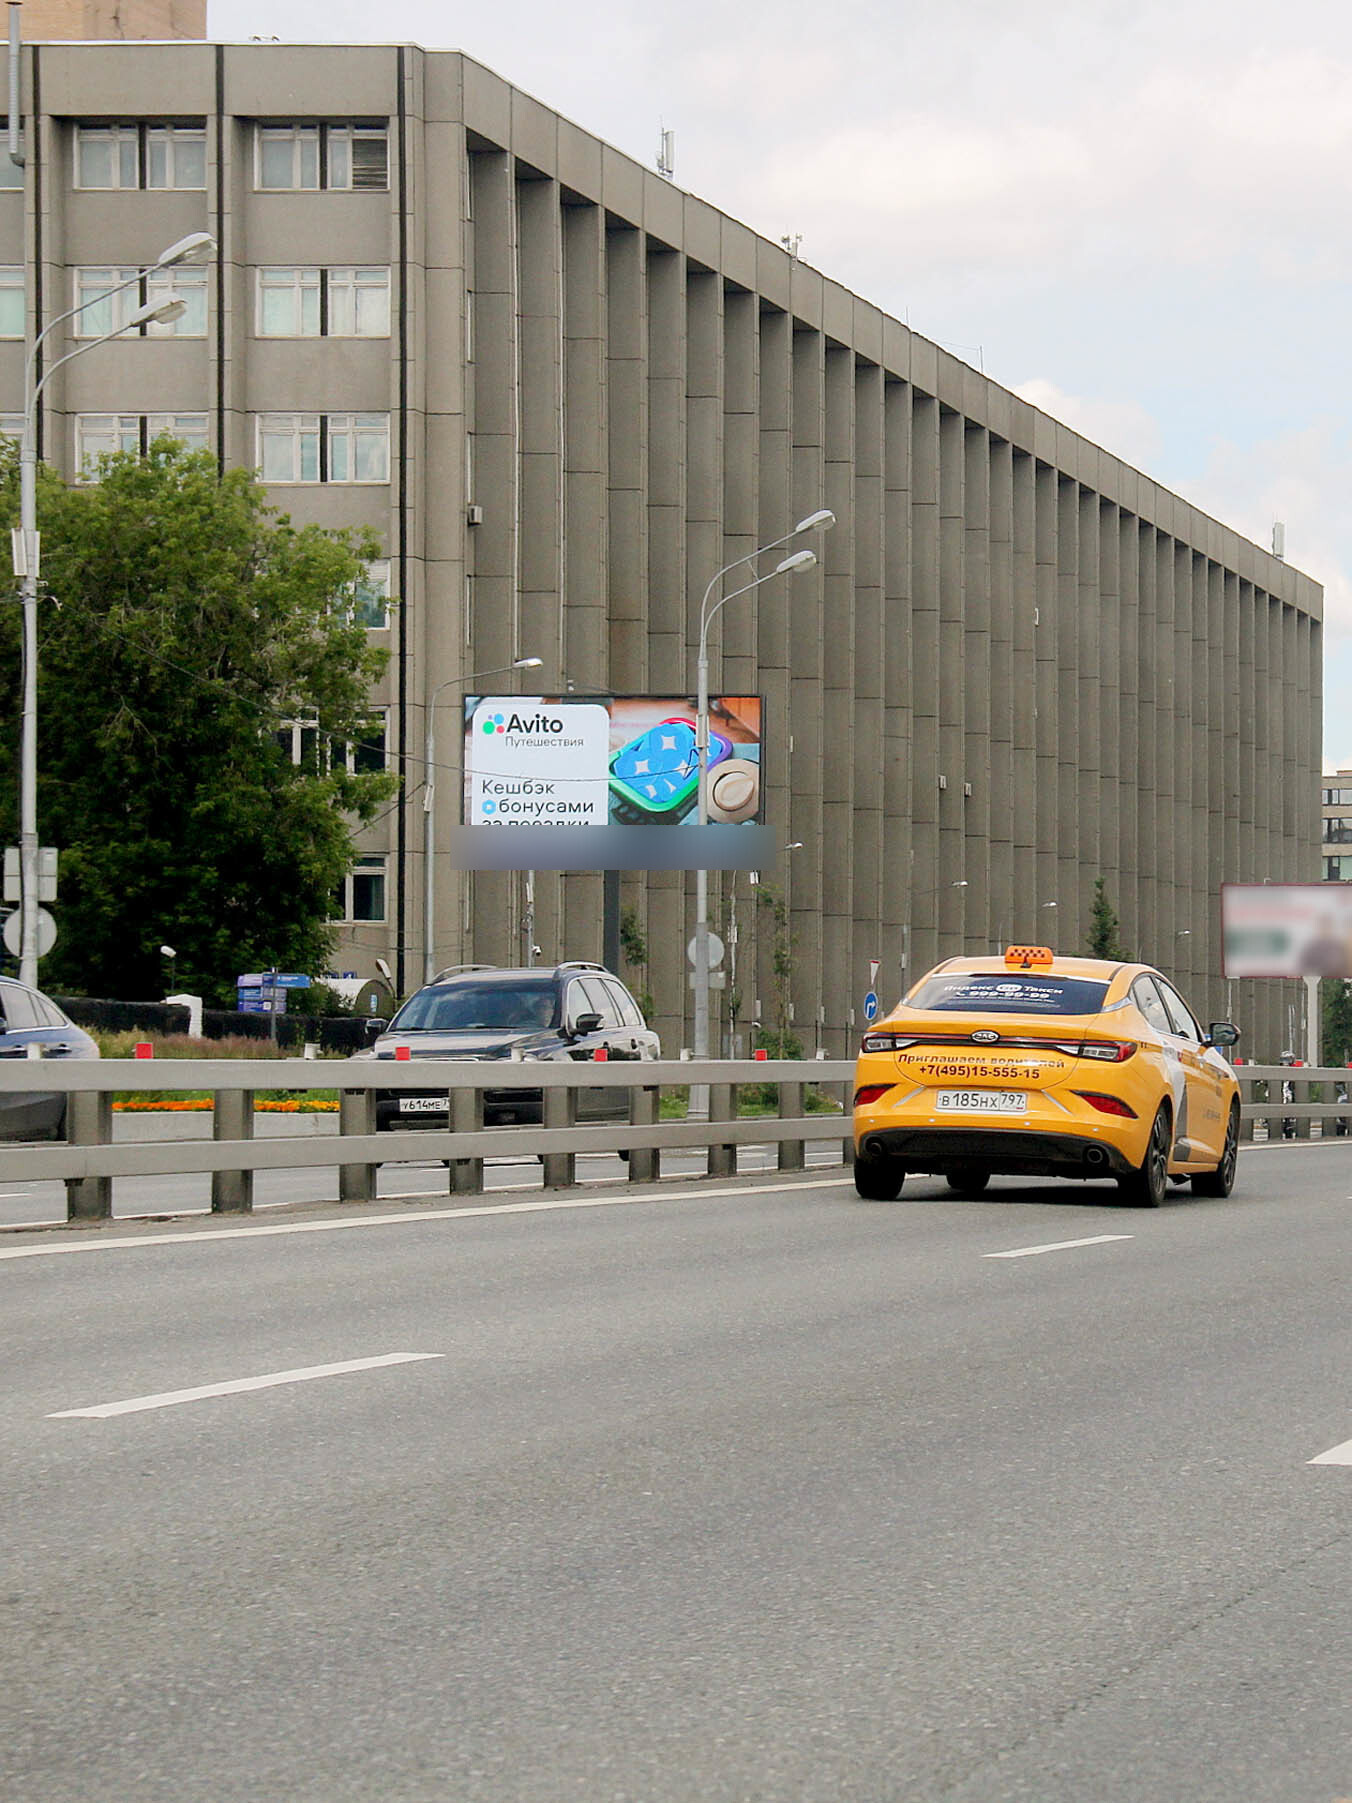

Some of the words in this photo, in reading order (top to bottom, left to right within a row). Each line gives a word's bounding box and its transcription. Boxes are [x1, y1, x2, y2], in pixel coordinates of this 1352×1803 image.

[507, 713, 564, 733] Avito
[505, 736, 584, 748] Путешествия
[482, 779, 555, 794] Кешбэк
[499, 799, 594, 816] бонусами
[898, 1054, 985, 1065] Приглашаем
[919, 1065, 1040, 1079] +7(495)15-555-15
[1001, 1093, 1024, 1106] 797
